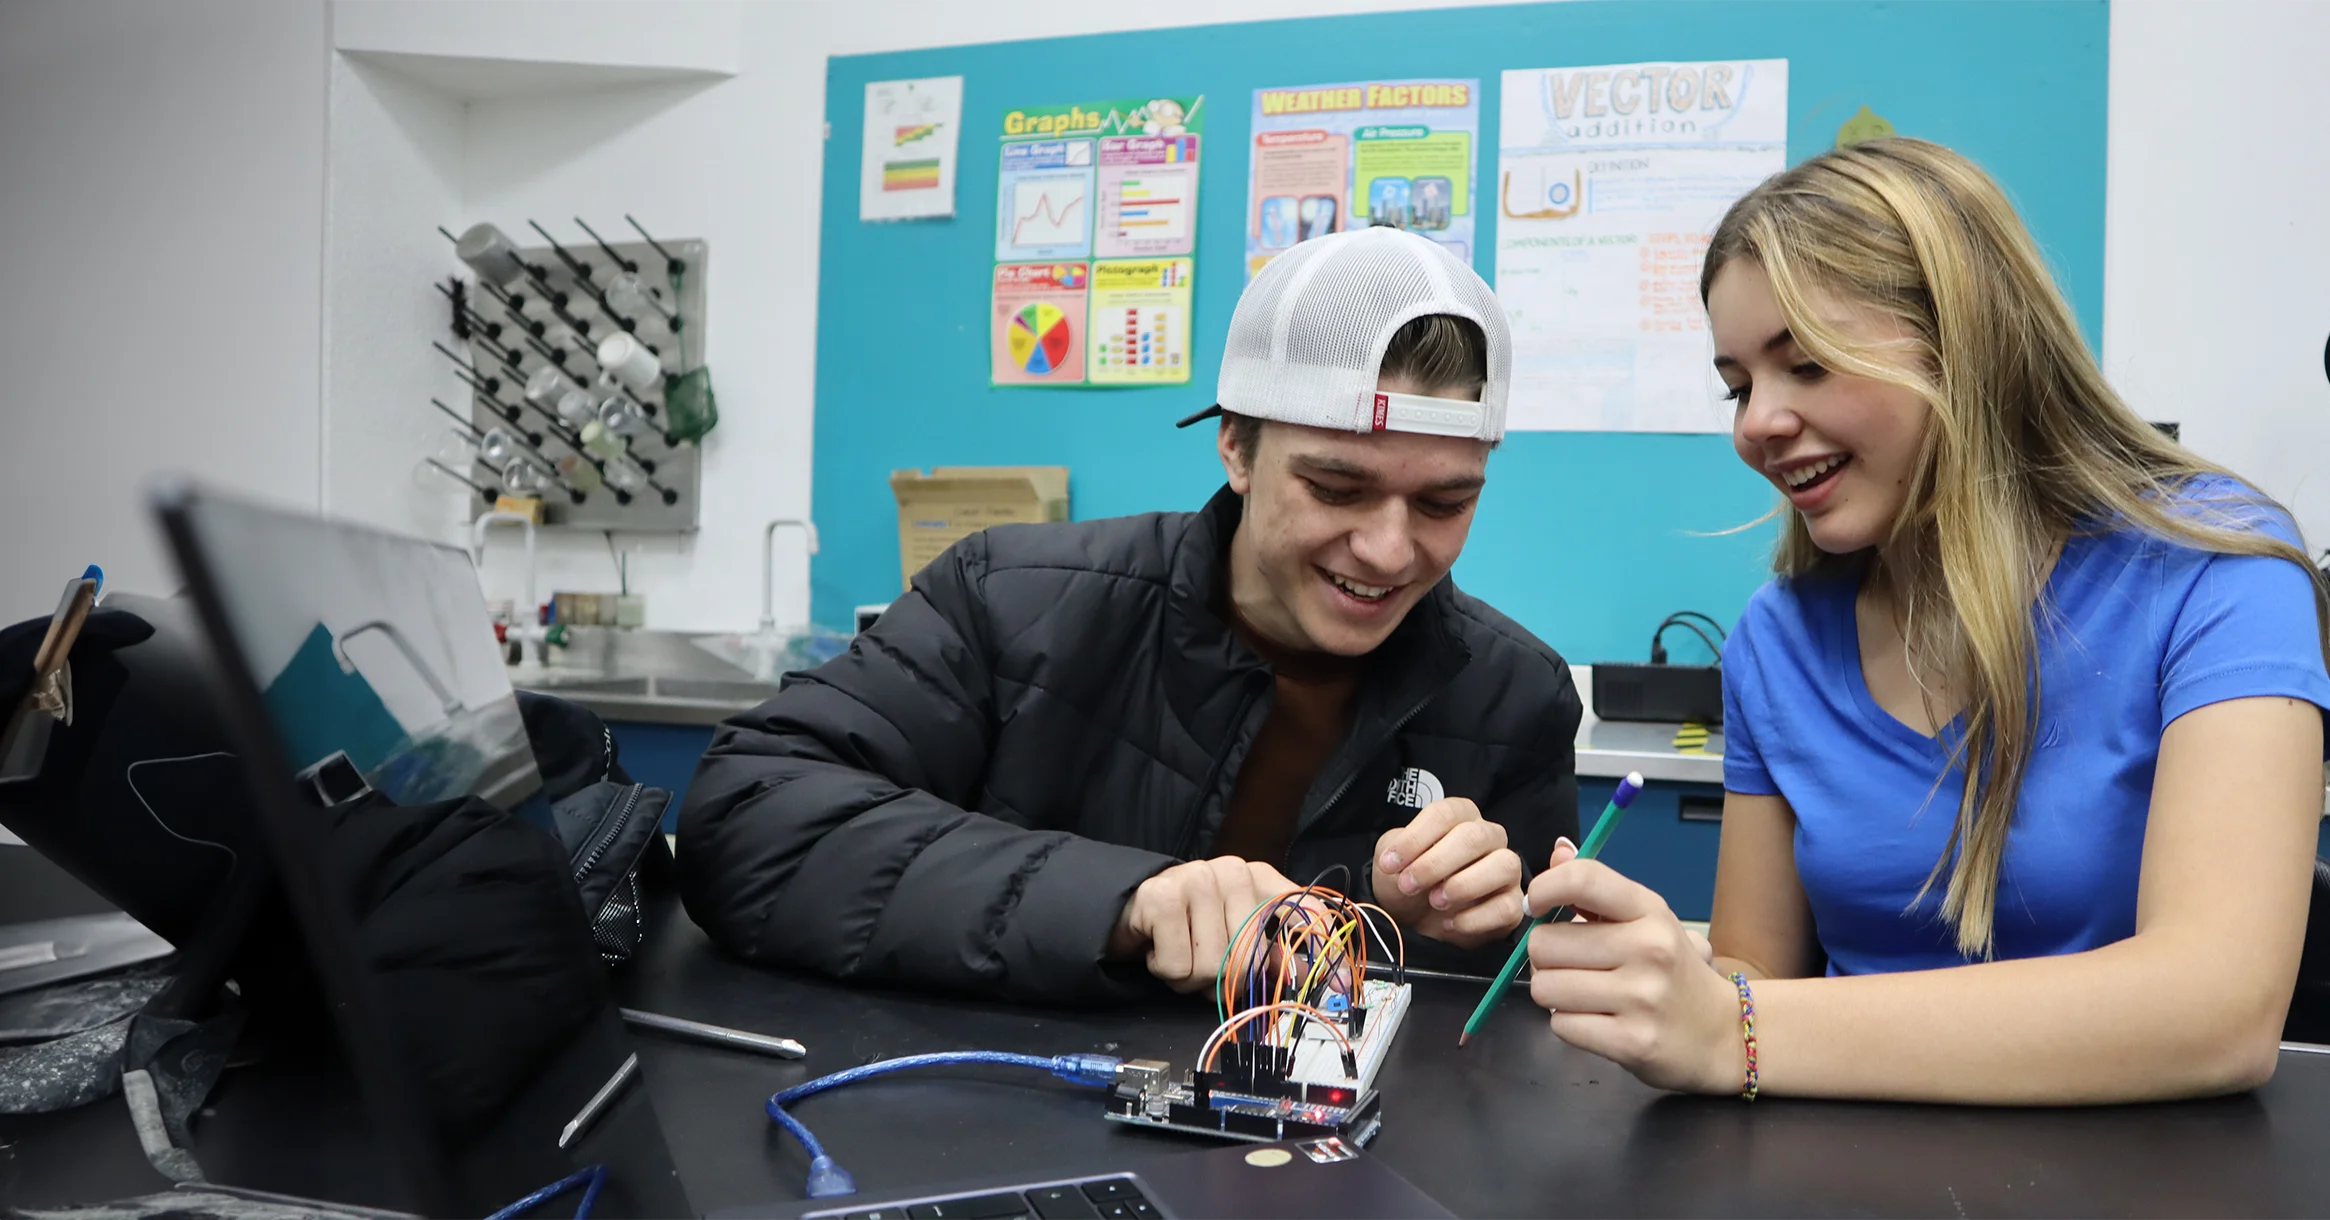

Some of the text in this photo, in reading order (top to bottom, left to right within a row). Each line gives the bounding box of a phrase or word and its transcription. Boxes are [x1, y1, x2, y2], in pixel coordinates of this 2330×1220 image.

[1261, 84, 1470, 116] WEATHER FACTORS
[1551, 64, 1734, 120] VECTOR
[1004, 106, 1100, 137] Graphs
[1567, 118, 1696, 138] addition
[1362, 127, 1424, 139] Air Pressure
[1030, 144, 1065, 156] Graph
[1126, 138, 1165, 151] Graph
[999, 264, 1050, 277] Pie Chart
